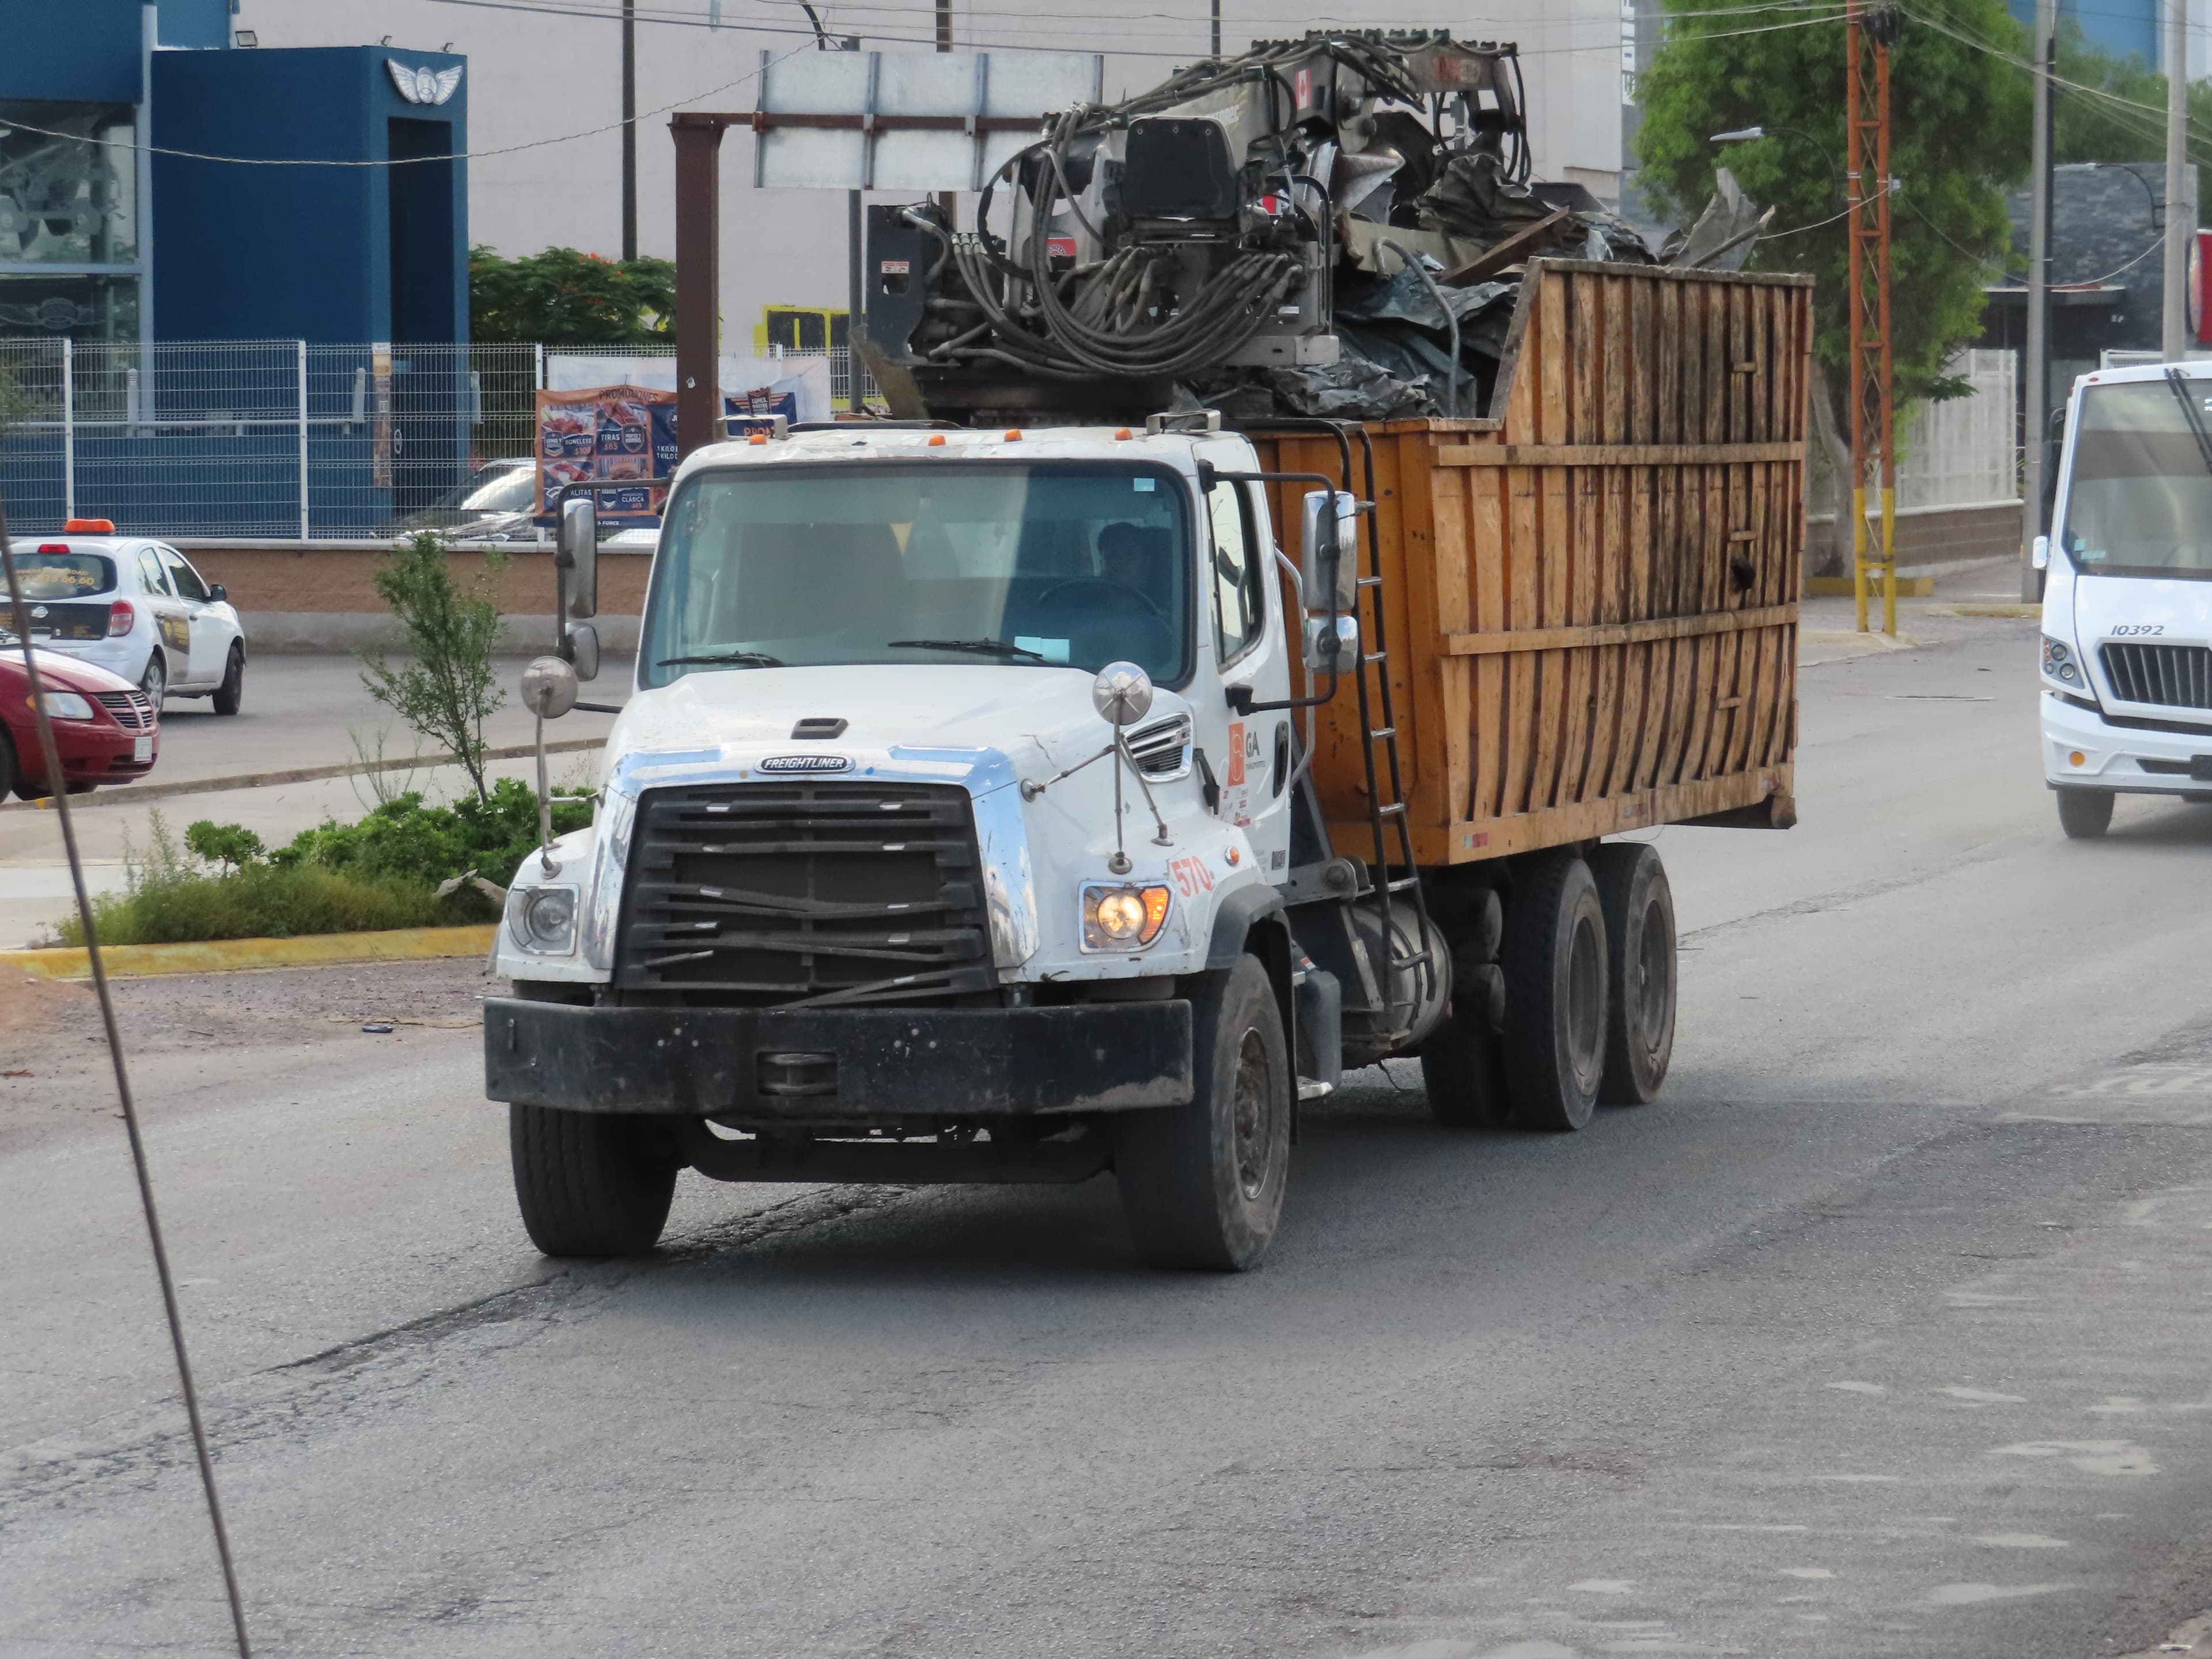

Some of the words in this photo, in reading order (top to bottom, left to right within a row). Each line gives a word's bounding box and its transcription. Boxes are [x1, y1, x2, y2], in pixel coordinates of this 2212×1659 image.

[2110, 625, 2164, 636] 10392
[1246, 731, 1260, 758] GA
[764, 757, 844, 769] FREIGHTLINER
[1171, 855, 1214, 897] 570
